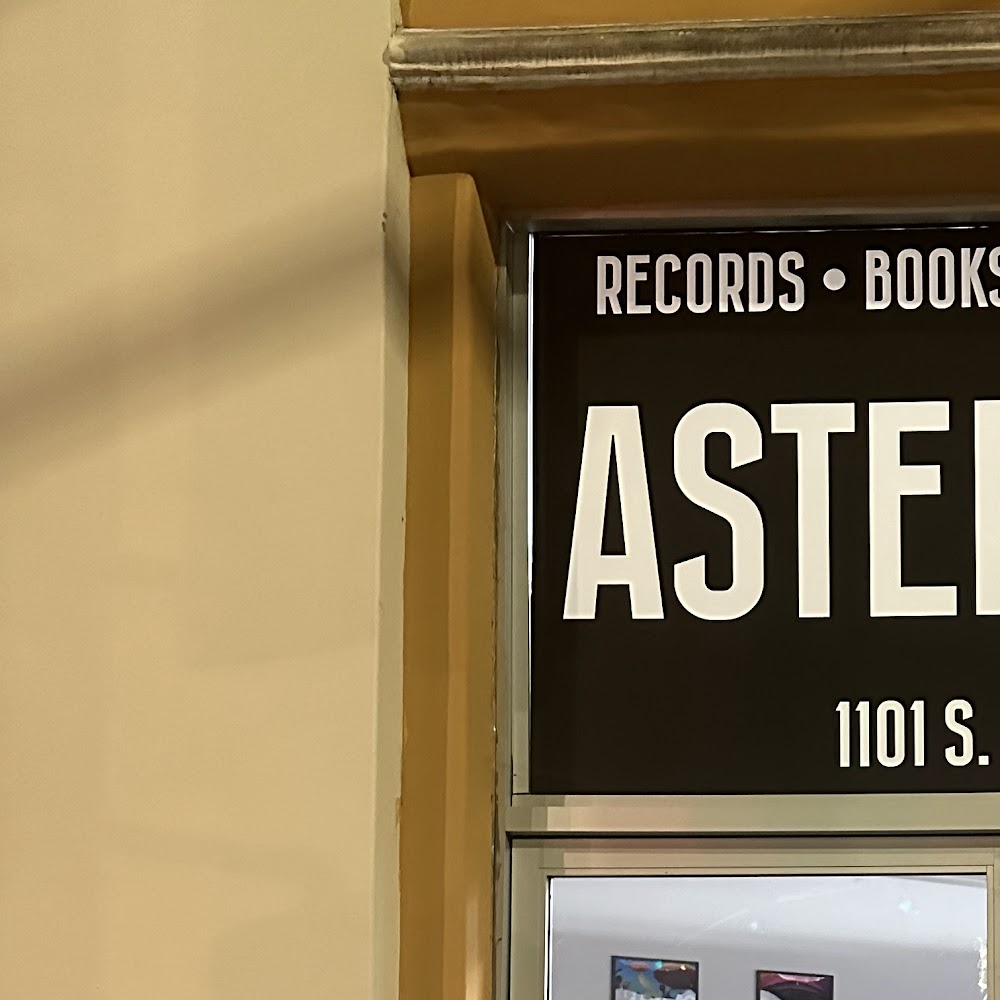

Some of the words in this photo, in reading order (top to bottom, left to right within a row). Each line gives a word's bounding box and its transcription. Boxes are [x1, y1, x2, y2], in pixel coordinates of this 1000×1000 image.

[596, 251, 805, 315] RECORDS
[835, 699, 925, 768] 1101
[944, 699, 990, 767] S.
